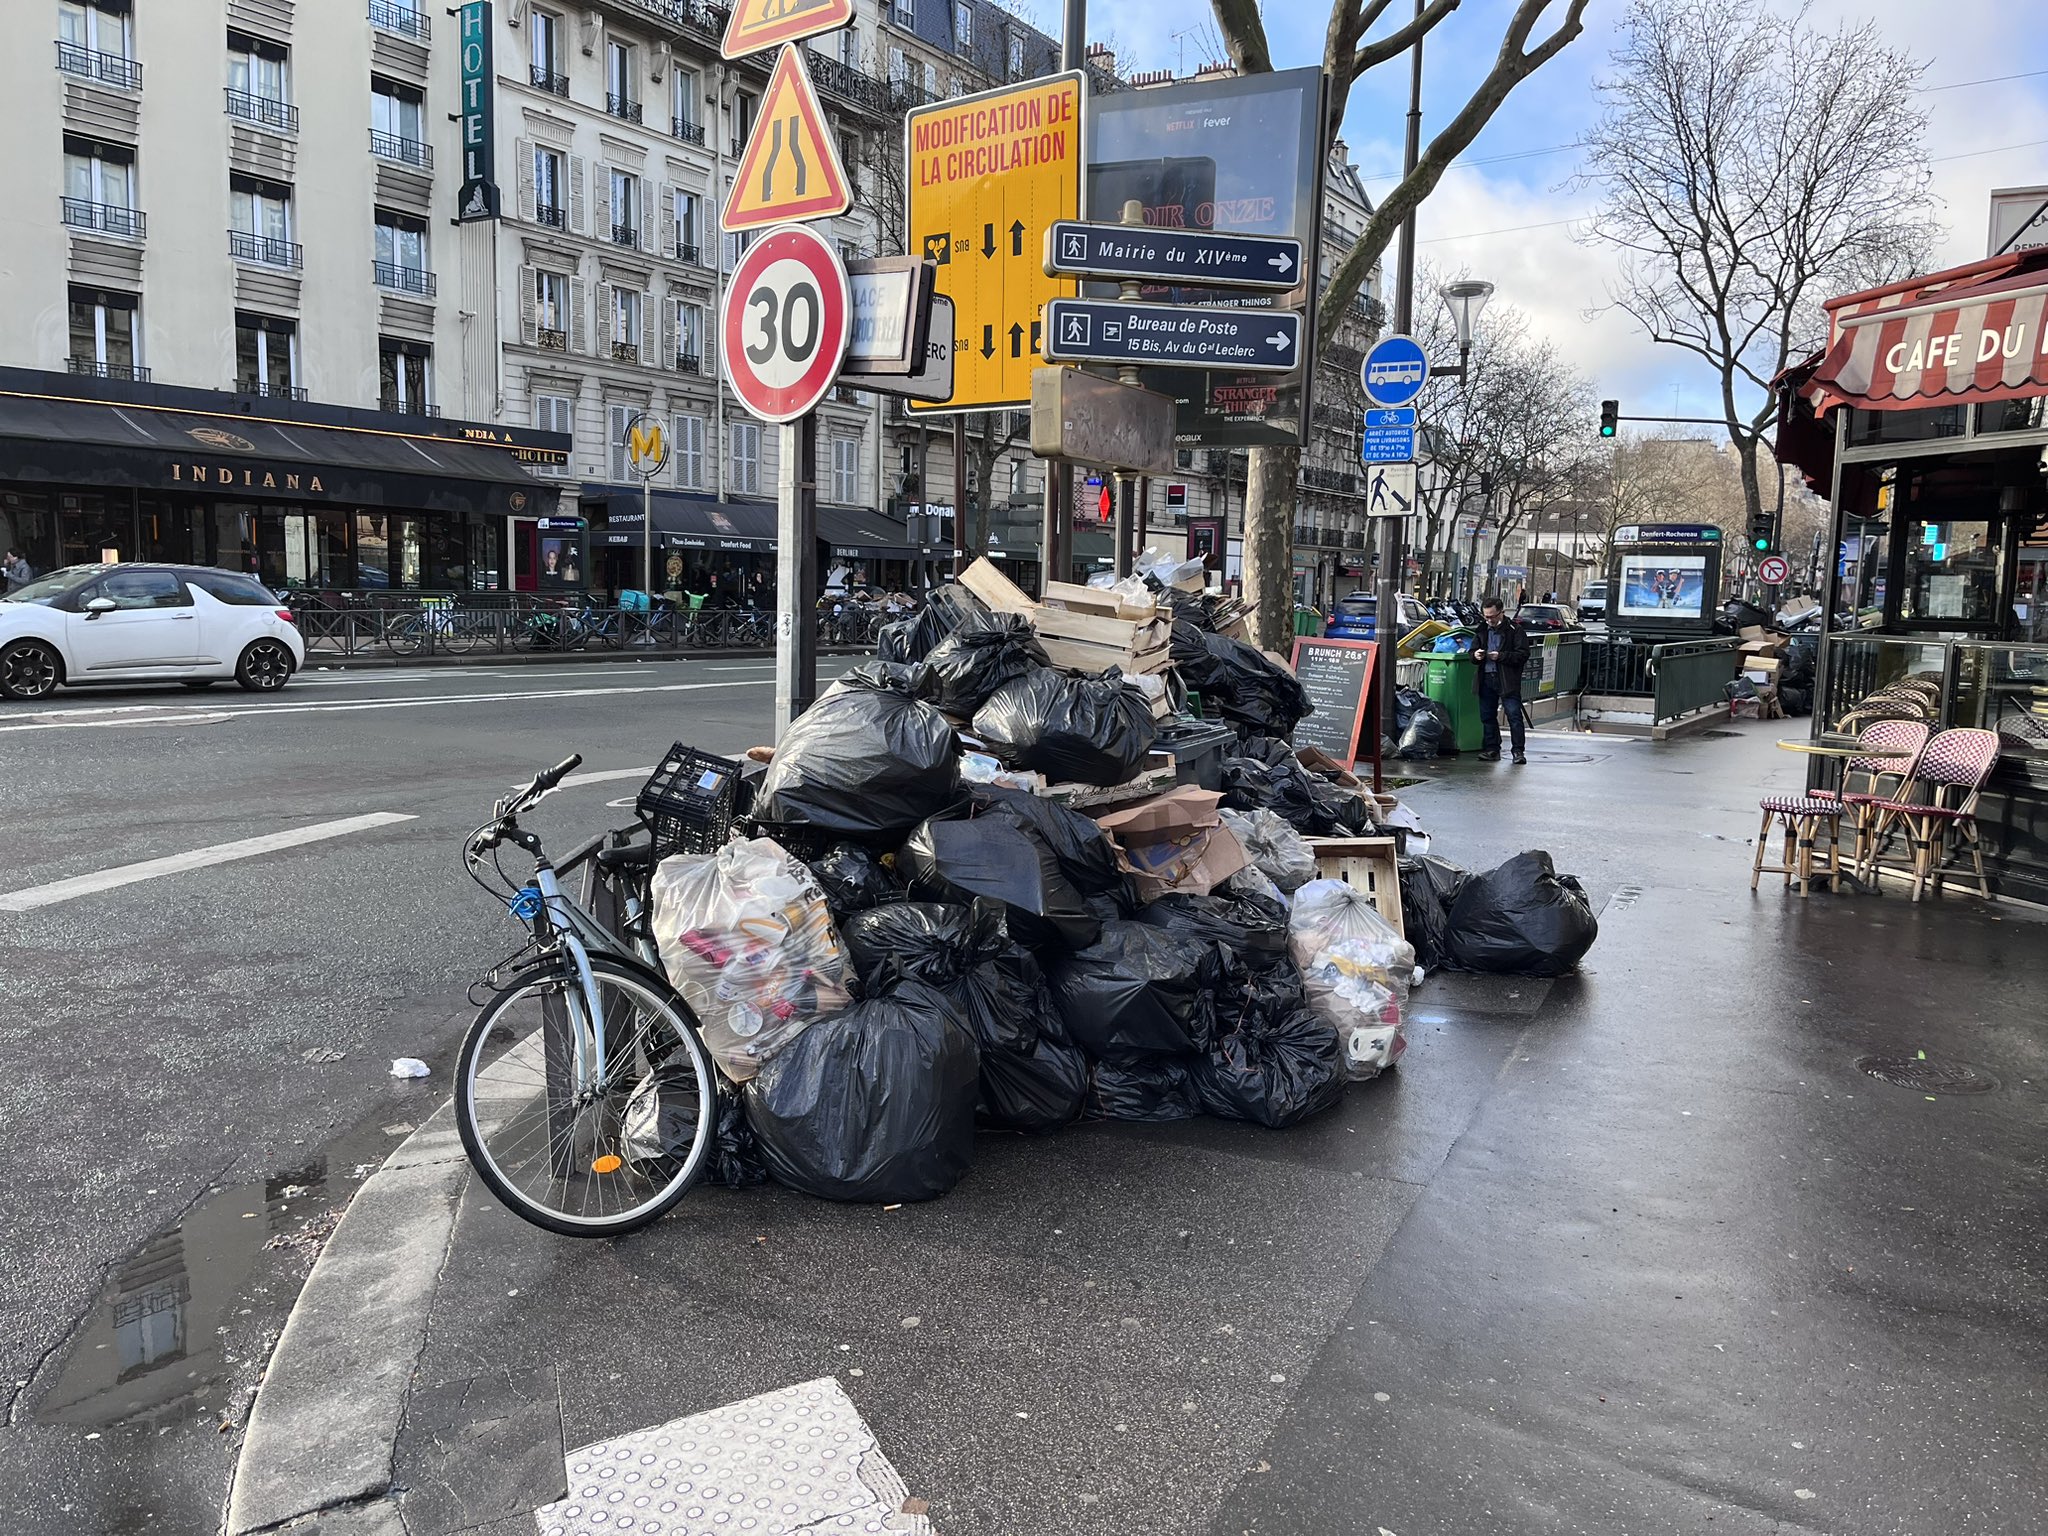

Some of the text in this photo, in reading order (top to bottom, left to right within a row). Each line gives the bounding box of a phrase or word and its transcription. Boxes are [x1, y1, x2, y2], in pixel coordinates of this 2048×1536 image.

[464, 6, 483, 180] HOTEL
[916, 90, 1073, 153] MODIFICATION DE
[1166, 116, 1231, 132] NETFLIX fever
[921, 130, 1065, 186] LA CIRCULATION
[1195, 197, 1276, 227] ONZE
[954, 239, 970, 253] BUS
[1099, 241, 1156, 260] Mairie
[1166, 247, 1186, 263] du
[853, 287, 886, 307] LACE
[1241, 298, 1271, 307] THINGS
[746, 282, 819, 364] 30
[1127, 315, 1238, 336] Bureau de Poste
[954, 339, 969, 352] BUS
[1127, 338, 1139, 351] 15
[1142, 339, 1162, 353] Bis,
[1165, 341, 1181, 353] Av
[1182, 341, 1196, 354] du
[1216, 343, 1255, 357] Leclerc
[1885, 333, 1963, 374] CAFE
[1976, 323, 2026, 363] DU
[1214, 386, 1278, 402] STRANGER
[1224, 401, 1268, 413] THINGS
[172, 464, 324, 492] INDIANA
[608, 513, 645, 523] RESTAURANT
[739, 541, 752, 550] Food
[1308, 647, 1342, 658] BRUNCH
